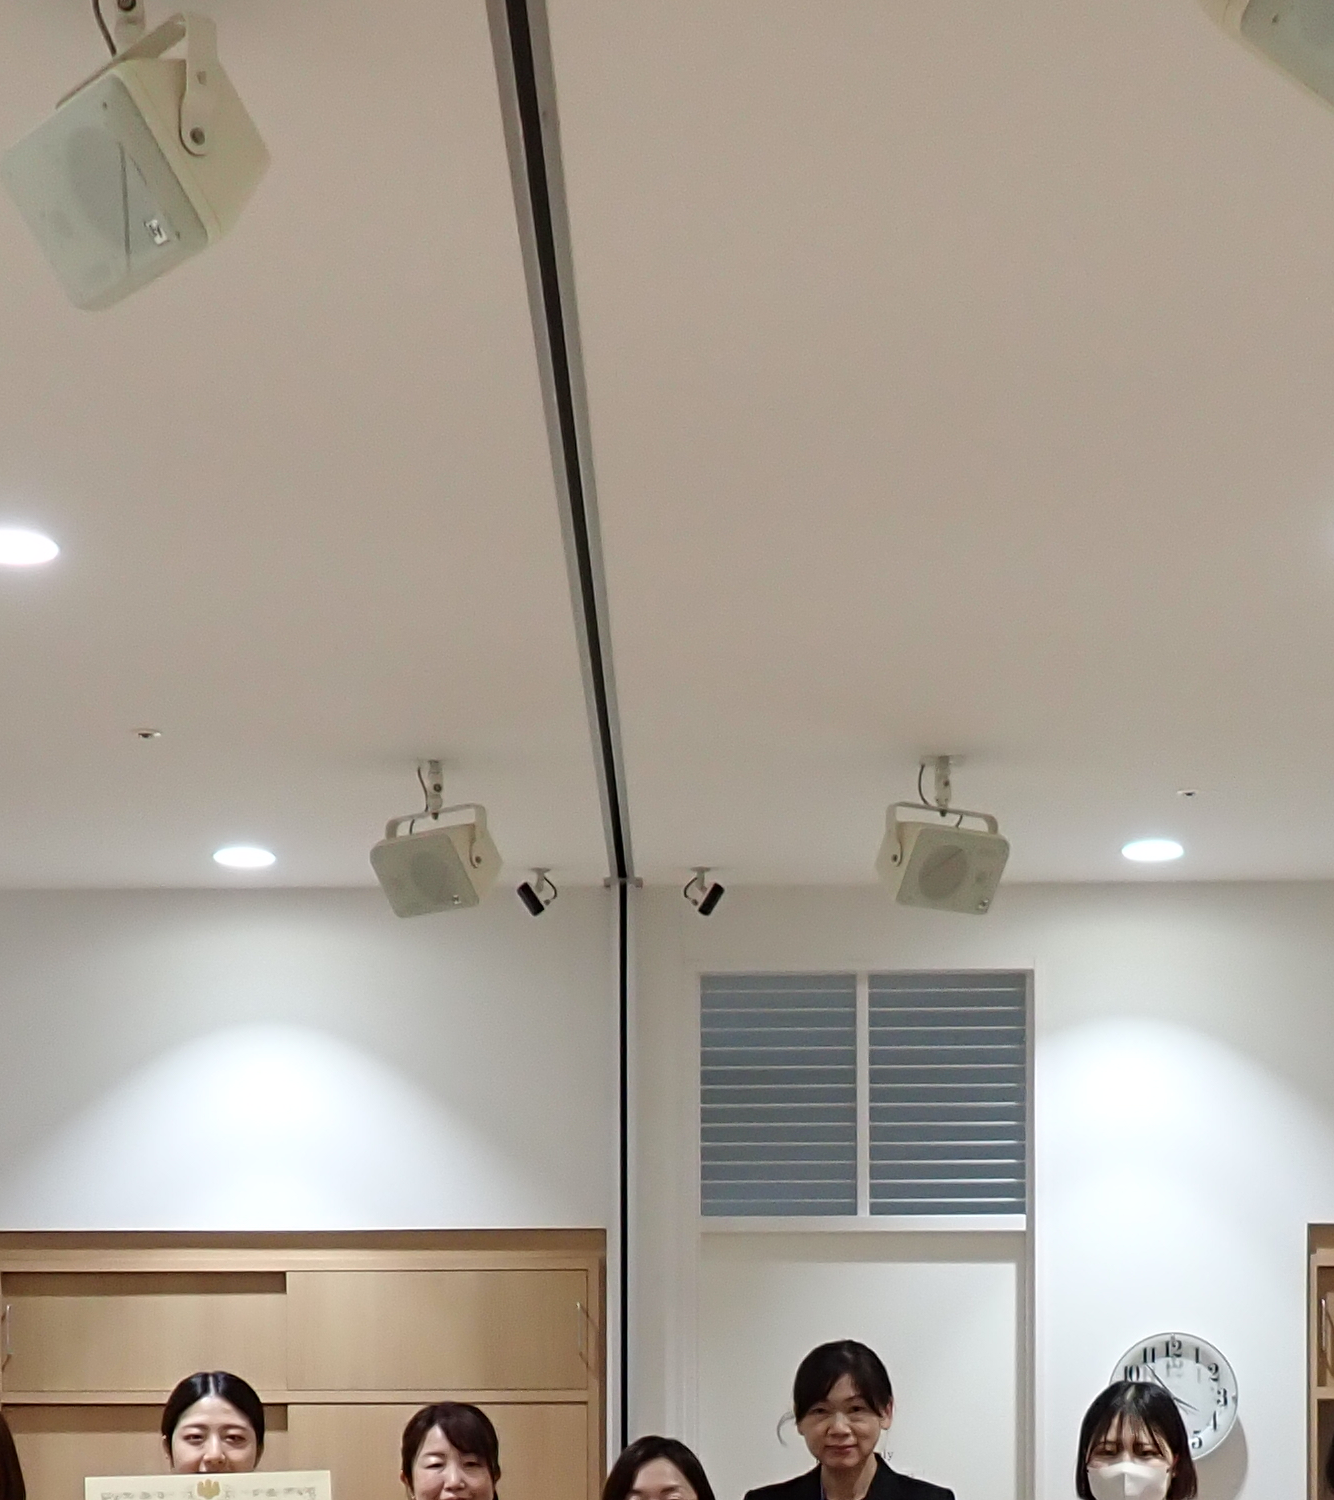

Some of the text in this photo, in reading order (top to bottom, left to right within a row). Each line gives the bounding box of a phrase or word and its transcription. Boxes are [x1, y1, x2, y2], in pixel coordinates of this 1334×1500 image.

[1165, 1340, 1183, 1358] 12
[1208, 1362, 1219, 1382] 2
[1191, 1430, 1203, 1449] 5
